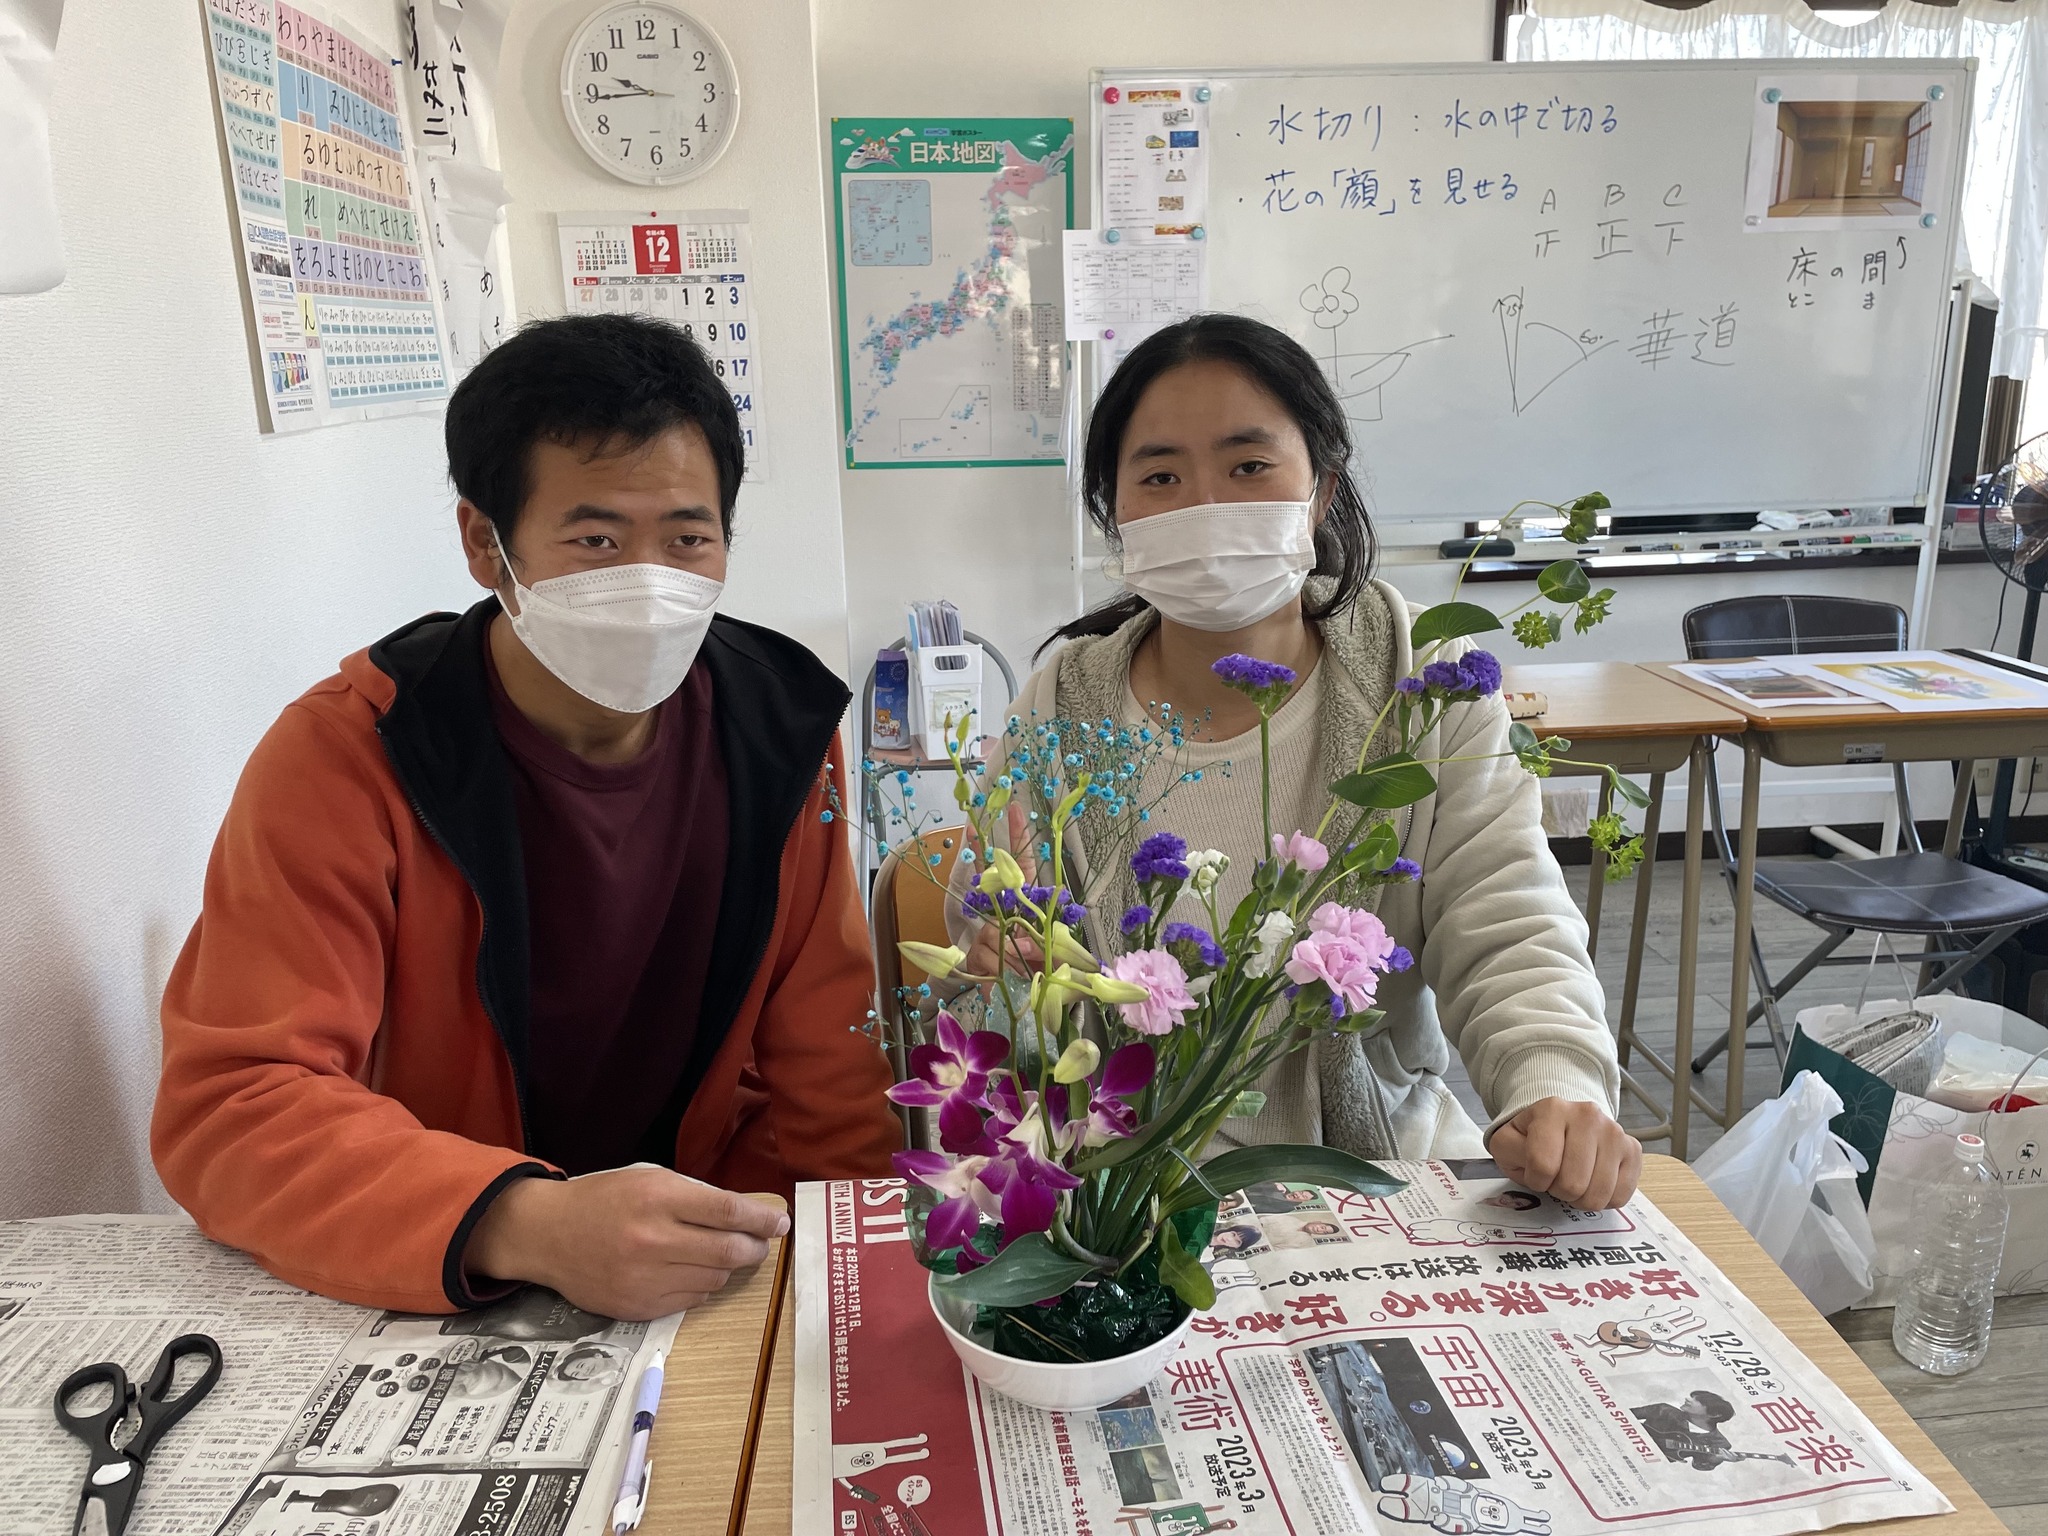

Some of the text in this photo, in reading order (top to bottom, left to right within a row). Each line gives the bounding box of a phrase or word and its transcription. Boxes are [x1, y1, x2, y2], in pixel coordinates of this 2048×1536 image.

[608, 29, 625, 49] 11
[636, 20, 656, 40] 12
[672, 28, 680, 48] 1
[589, 52, 607, 72] 10
[693, 51, 706, 71] 2
[586, 83, 599, 103] 9
[704, 83, 715, 103] 3
[598, 115, 610, 134] 8
[695, 113, 708, 132] 4
[620, 138, 631, 156] 7
[651, 145, 663, 165] 6
[680, 138, 691, 157] 5
[910, 141, 996, 164] 日本地図
[1541, 184, 1688, 214] A B C
[1593, 219, 1633, 259] 正
[646, 237, 670, 262] 12
[1786, 247, 1886, 286] 床の間
[581, 287, 739, 305] 27 28 29 30 1 2 3
[1788, 291, 1875, 310] とこ ま
[708, 323, 717, 341] 9
[729, 323, 746, 341] 10
[1627, 301, 1739, 371] 華道
[732, 359, 748, 377] 17
[734, 394, 751, 411] 24
[1326, 1190, 1393, 1238] 文化
[1369, 1268, 1701, 1322] 好きが深まる。
[1709, 1330, 1771, 1378] 12/28
[1420, 1335, 1505, 1409] 宇宙
[1164, 1358, 1237, 1431] 美術
[1751, 1397, 1865, 1475] 音楽
[1481, 1431, 1519, 1474] 放送予定
[1490, 1416, 1553, 1490] 2023年3月
[1203, 1453, 1232, 1499] 放送予定
[1216, 1435, 1266, 1514] 2023年3月
[844, 1514, 855, 1525] BS
